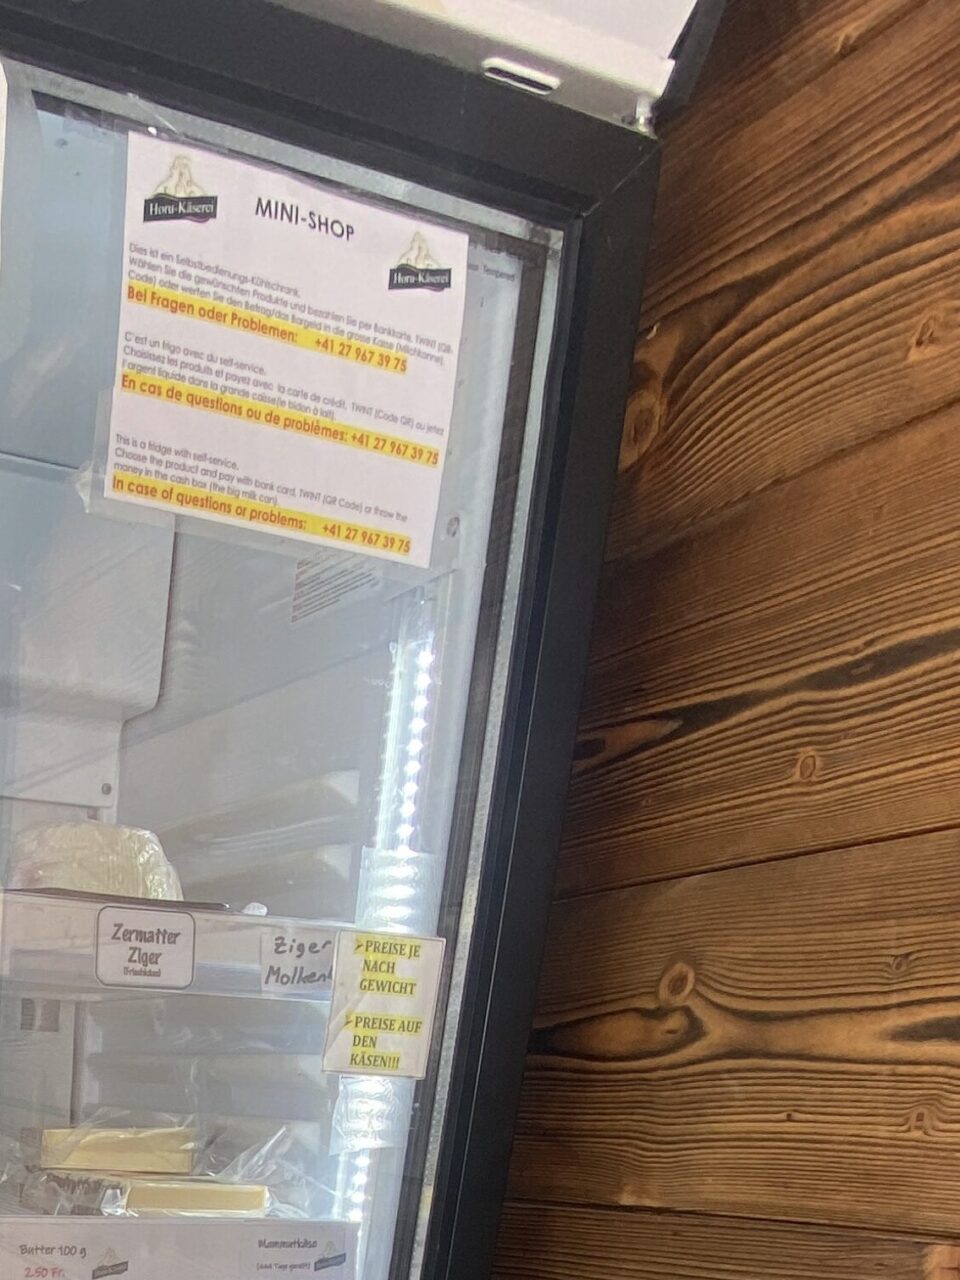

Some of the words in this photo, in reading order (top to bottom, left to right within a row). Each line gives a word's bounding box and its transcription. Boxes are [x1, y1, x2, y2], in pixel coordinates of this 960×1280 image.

[254, 196, 354, 241] MINI-SHOP
[127, 285, 147, 303] Bei
[150, 291, 194, 315] Fragen
[197, 306, 227, 323] oder
[230, 312, 298, 342] Problemen:
[314, 337, 334, 353] +41
[338, 342, 352, 357] 27
[354, 346, 373, 363] 967
[377, 352, 391, 367] 39
[393, 356, 407, 372] 75
[121, 373, 136, 390] En
[139, 381, 162, 396] cas
[165, 385, 182, 401] de
[185, 392, 243, 416] questions
[246, 407, 261, 420] ou
[264, 409, 281, 425] de
[283, 416, 348, 442] problèmes:
[350, 432, 369, 447] +41
[373, 436, 386, 451] 27
[389, 440, 408, 456] 967
[410, 446, 423, 460] 39
[426, 450, 438, 465] 75
[112, 474, 124, 490] In
[127, 481, 157, 497] case
[161, 486, 173, 501] of
[175, 491, 232, 514] questions
[235, 504, 247, 517] or
[249, 508, 306, 530] problems:
[322, 523, 341, 537] +41
[345, 526, 358, 541] 27
[360, 530, 380, 545] 967
[382, 535, 395, 549] 39
[398, 538, 410, 553] 75
[110, 922, 181, 946] Zermatter
[127, 946, 163, 967] Ziger
[273, 935, 333, 959] Ziger
[365, 939, 406, 956] PREISE
[408, 943, 422, 957] JE
[361, 958, 396, 975] NACH
[358, 978, 418, 996] GEWICHT
[354, 1015, 396, 1032] PREISE
[397, 1018, 423, 1034] AUF
[352, 1034, 377, 1049] DEN
[349, 1052, 401, 1070] KÄSEN!!!
[19, 1243, 56, 1256] Butter
[57, 1244, 78, 1256] 100
